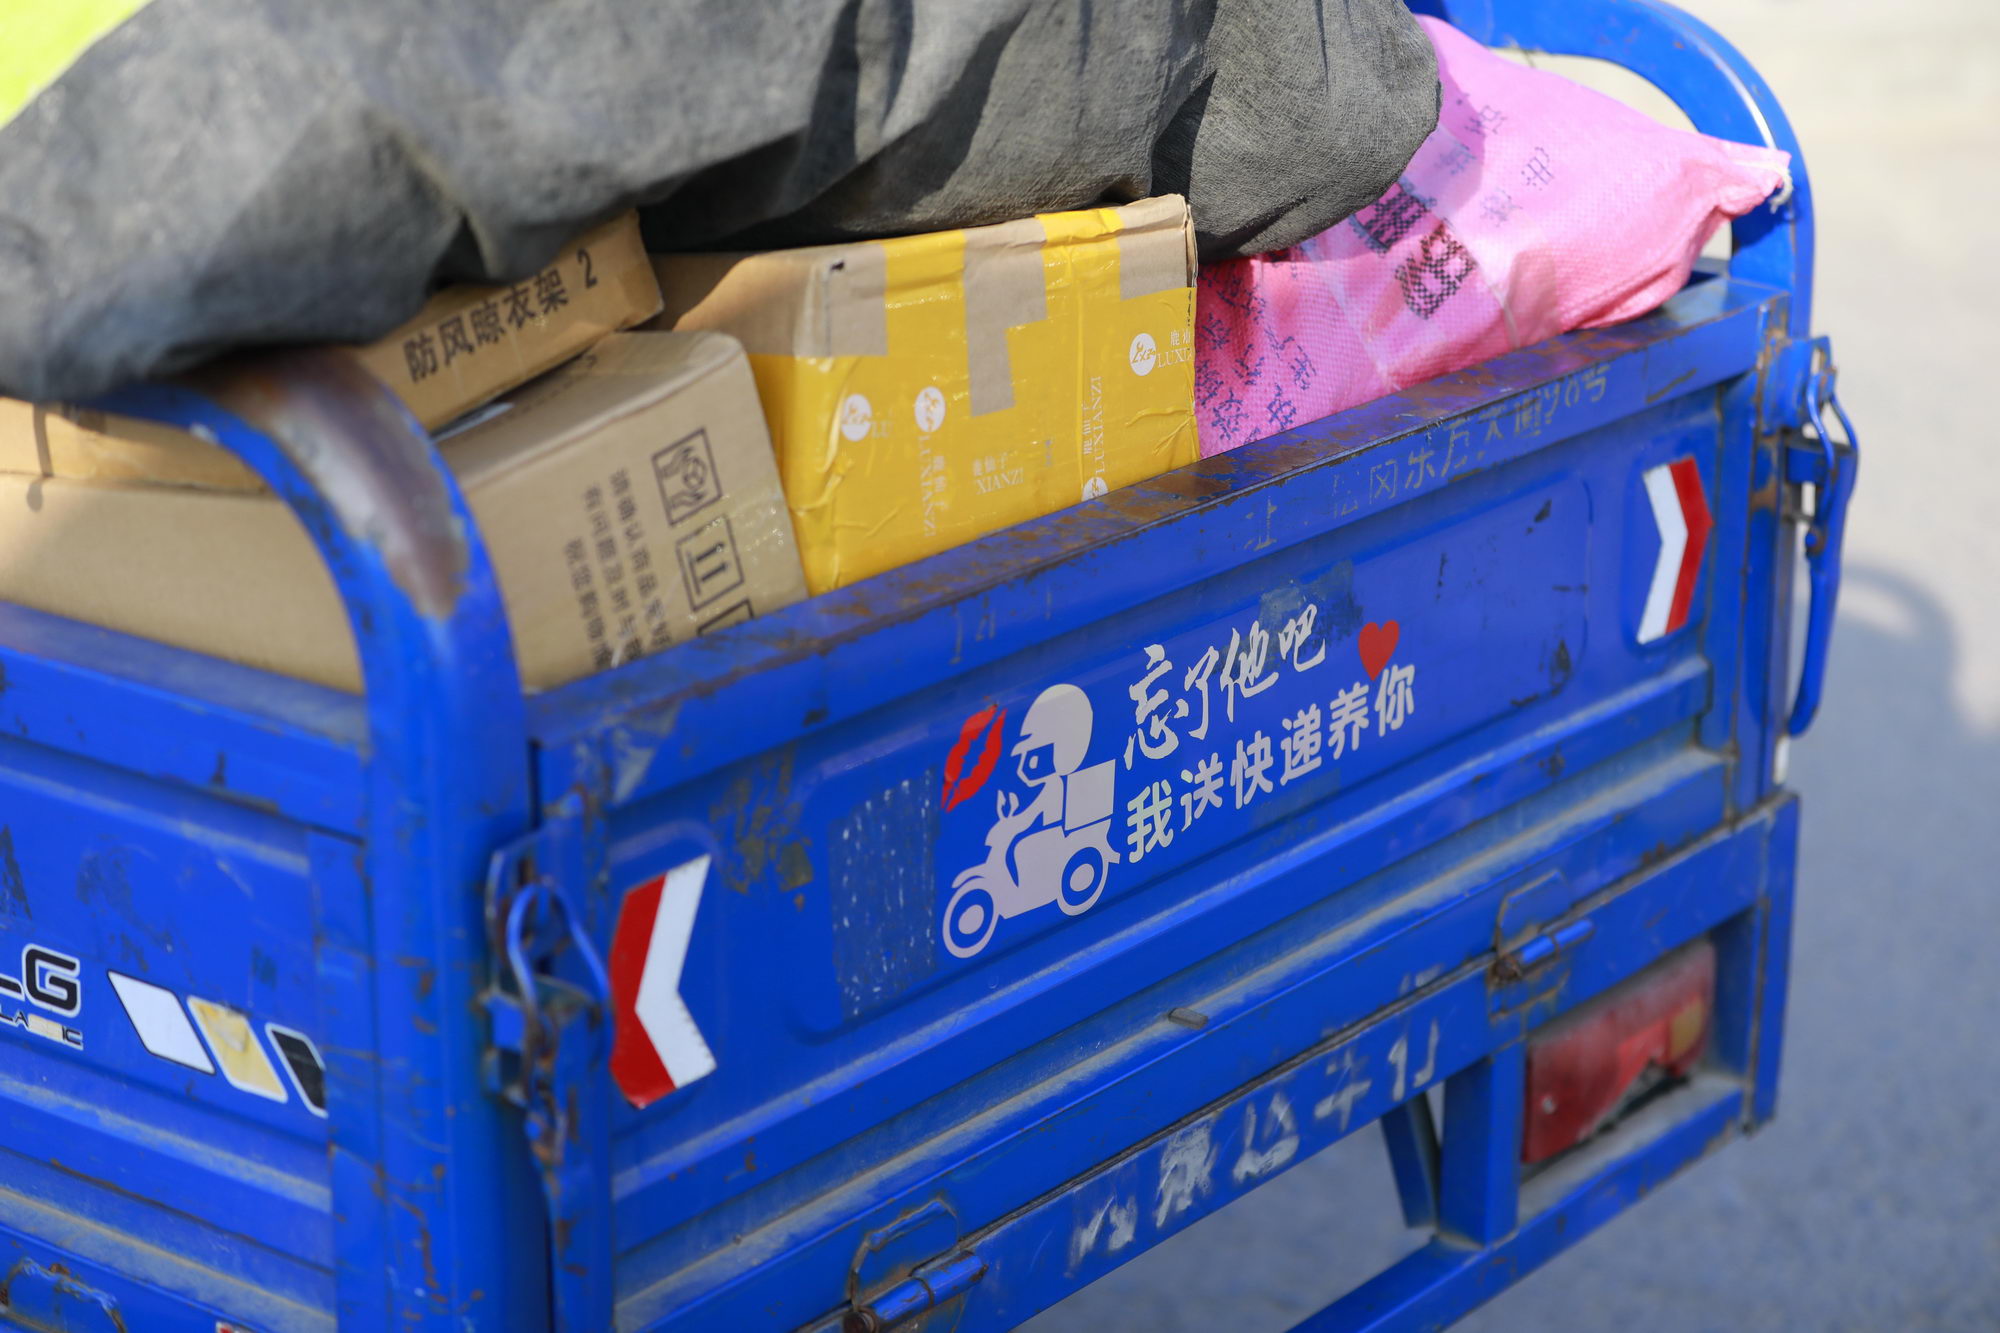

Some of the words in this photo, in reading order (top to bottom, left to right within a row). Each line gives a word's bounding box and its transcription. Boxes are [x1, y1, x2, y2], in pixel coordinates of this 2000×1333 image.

[403, 272, 570, 383] 防风晾衣架
[577, 248, 598, 289] 2
[1124, 603, 1327, 770] 忘了他吧
[1126, 663, 1416, 863] 我送快递养你
